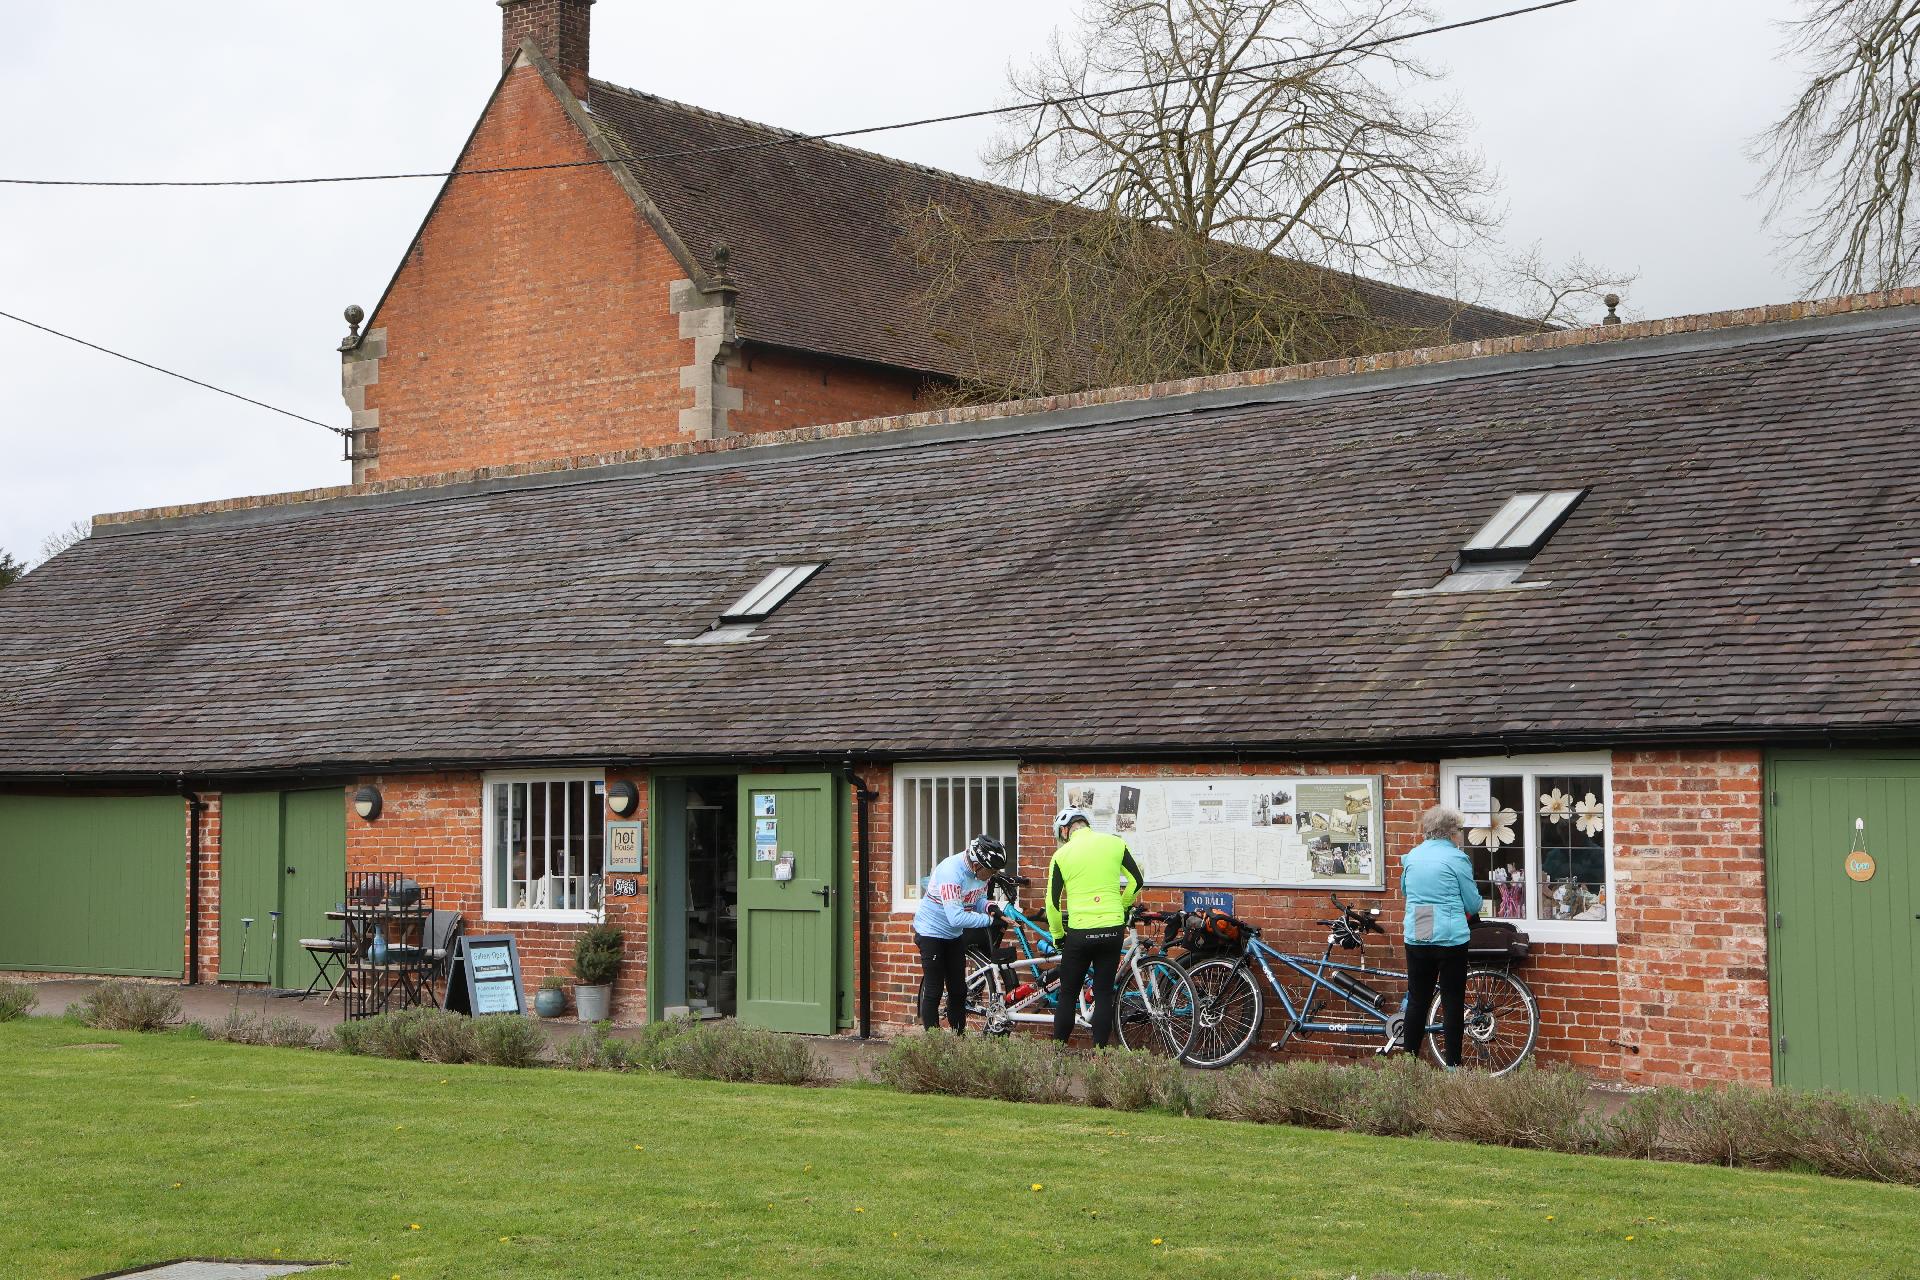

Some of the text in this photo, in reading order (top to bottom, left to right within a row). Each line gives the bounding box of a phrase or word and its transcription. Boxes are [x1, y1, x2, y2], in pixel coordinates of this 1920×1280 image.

[615, 828, 634, 844] hot
[1191, 896, 1226, 906] NO BALL
[1328, 1023, 1348, 1032] orbit
